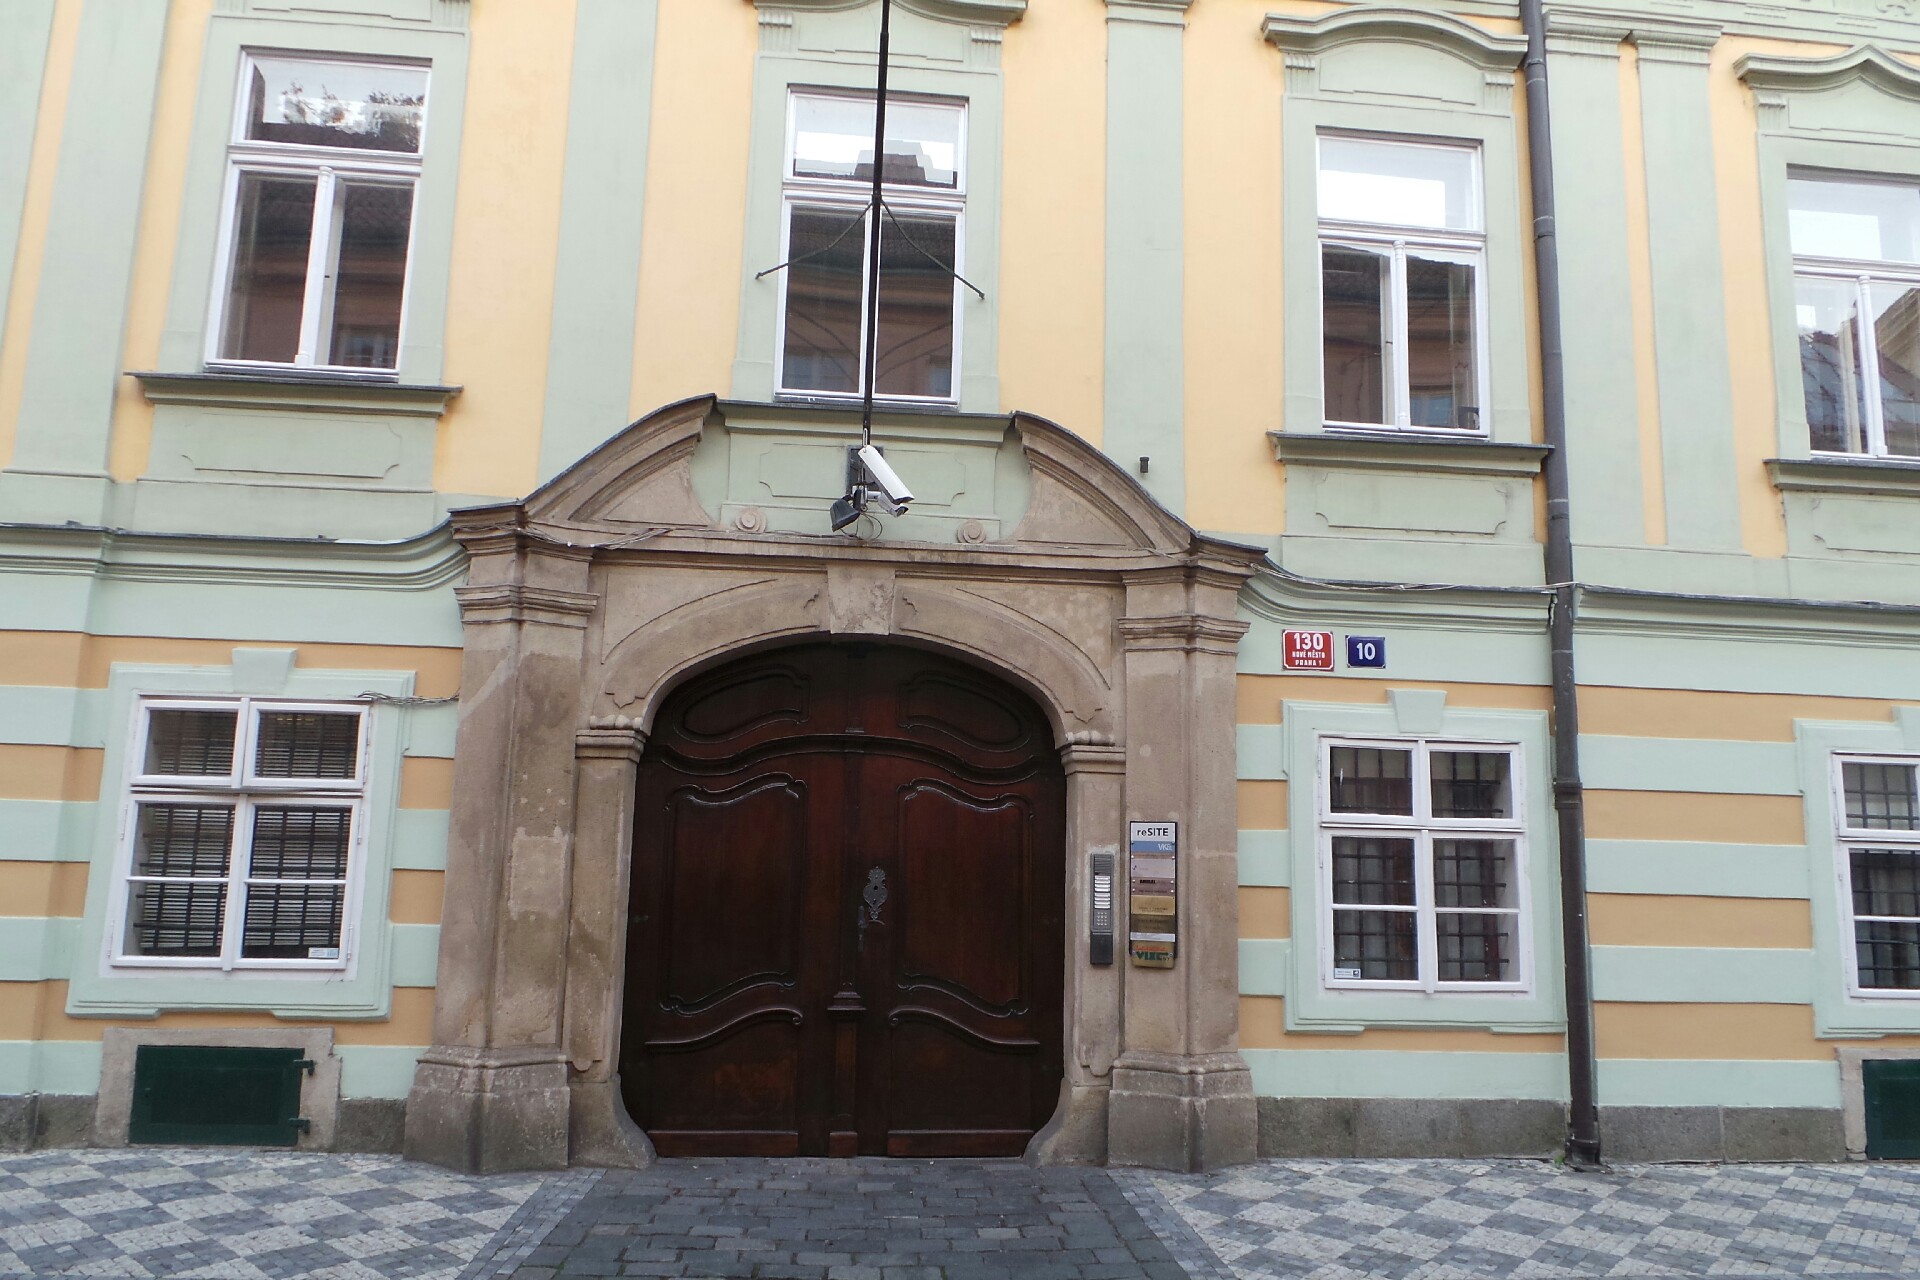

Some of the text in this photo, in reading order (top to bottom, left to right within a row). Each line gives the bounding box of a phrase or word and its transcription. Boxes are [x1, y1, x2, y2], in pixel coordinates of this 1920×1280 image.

[1294, 633, 1324, 650] 130
[1292, 650, 1325, 658] NOVÉ MĚSTO
[1356, 642, 1376, 660] 10
[1137, 827, 1169, 837] reSITE
